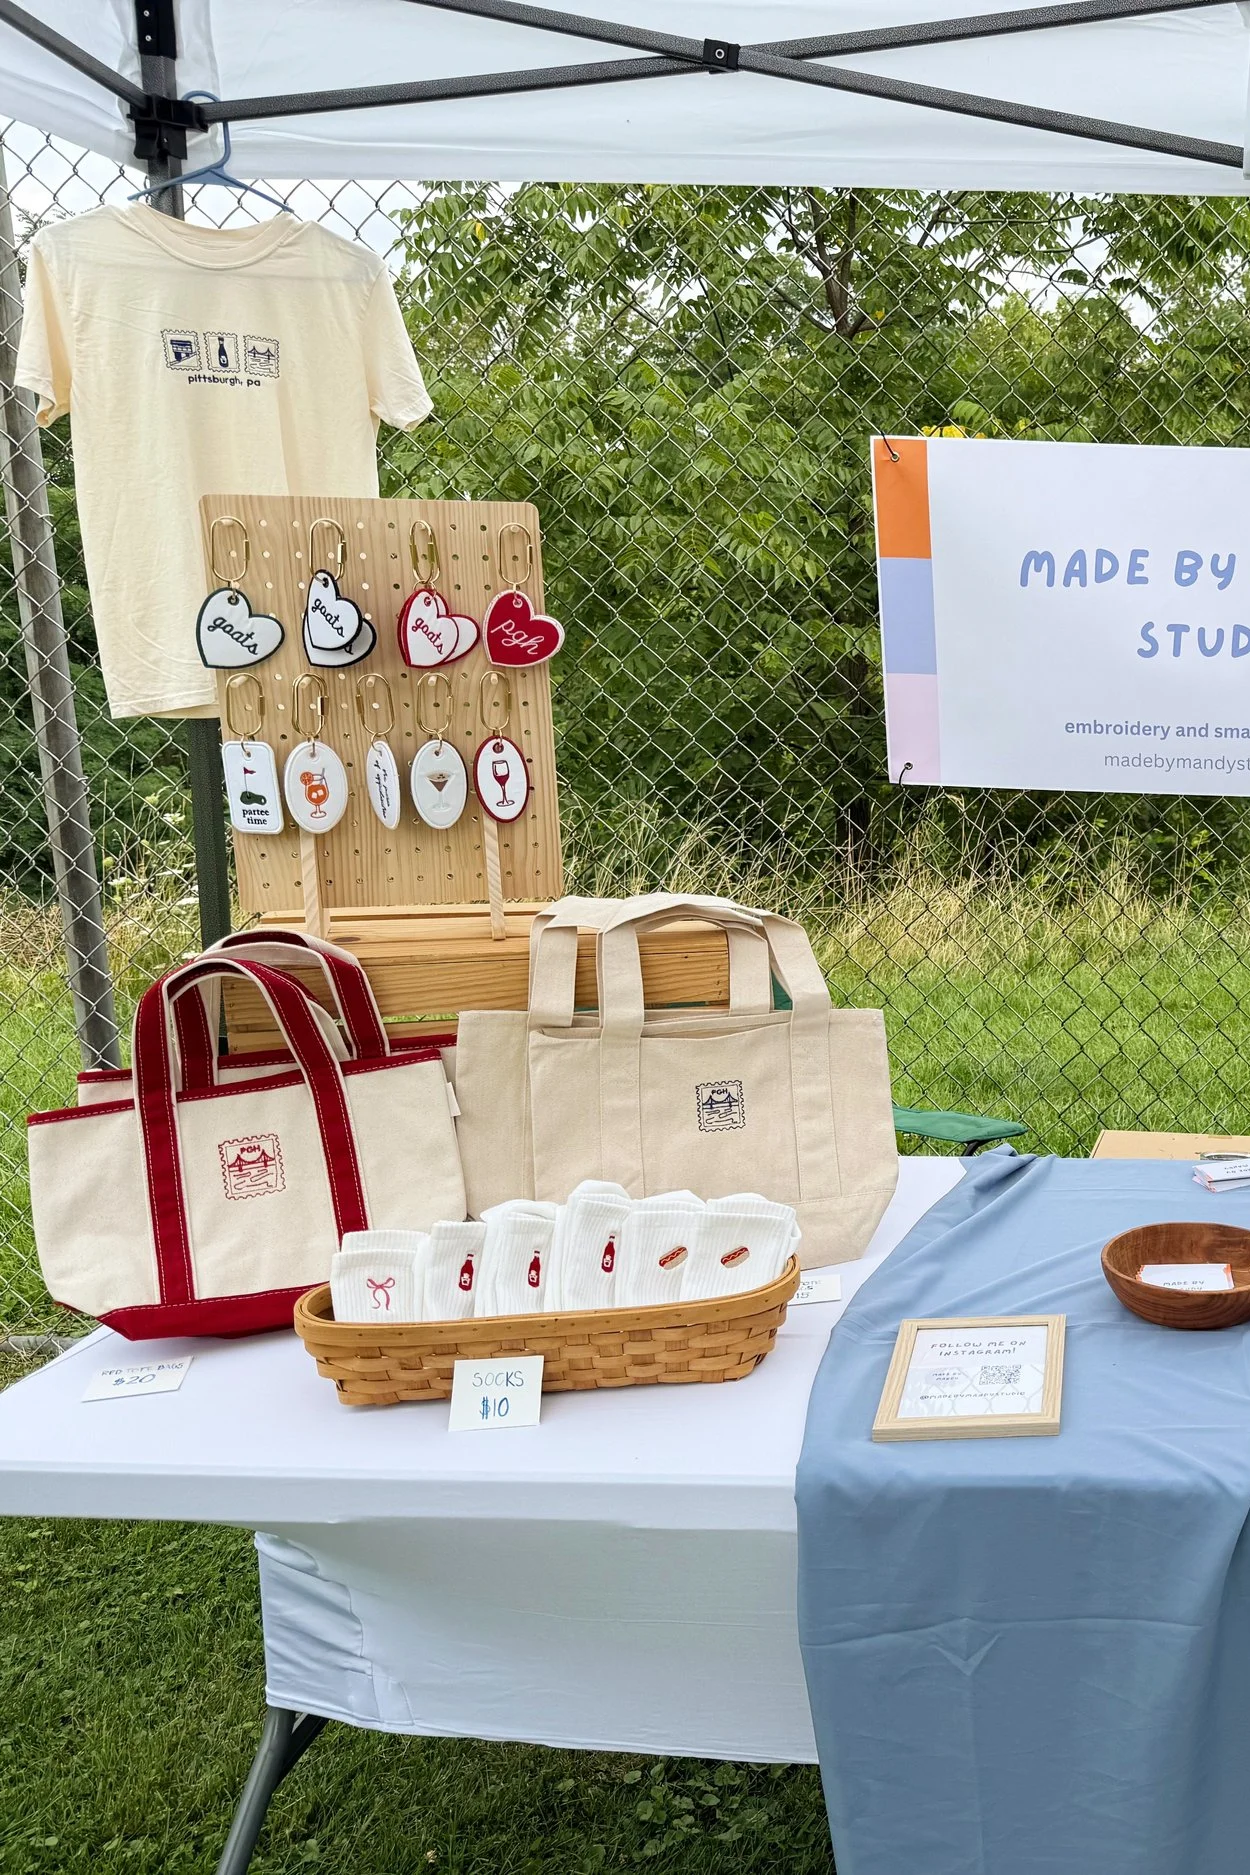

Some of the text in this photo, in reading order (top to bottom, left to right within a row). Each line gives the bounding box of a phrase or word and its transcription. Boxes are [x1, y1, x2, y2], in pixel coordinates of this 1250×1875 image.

[188, 374, 261, 387] pittsburgh, pa
[1020, 548, 1149, 587] MADE
[1174, 550, 1236, 591] BY
[311, 598, 345, 638] goats
[207, 616, 258, 656] goats
[411, 617, 443, 655] goats
[490, 619, 545, 655] pgh
[1064, 719, 1171, 740] embroidery
[1175, 723, 1209, 738] and
[242, 808, 270, 818] partee
[247, 816, 268, 825] time
[240, 1144, 261, 1154] PGH
[939, 1347, 1017, 1357] INSTAGRAM!
[112, 1373, 157, 1386] $20
[472, 1370, 524, 1388] SOCKS
[479, 1396, 510, 1420] $10
